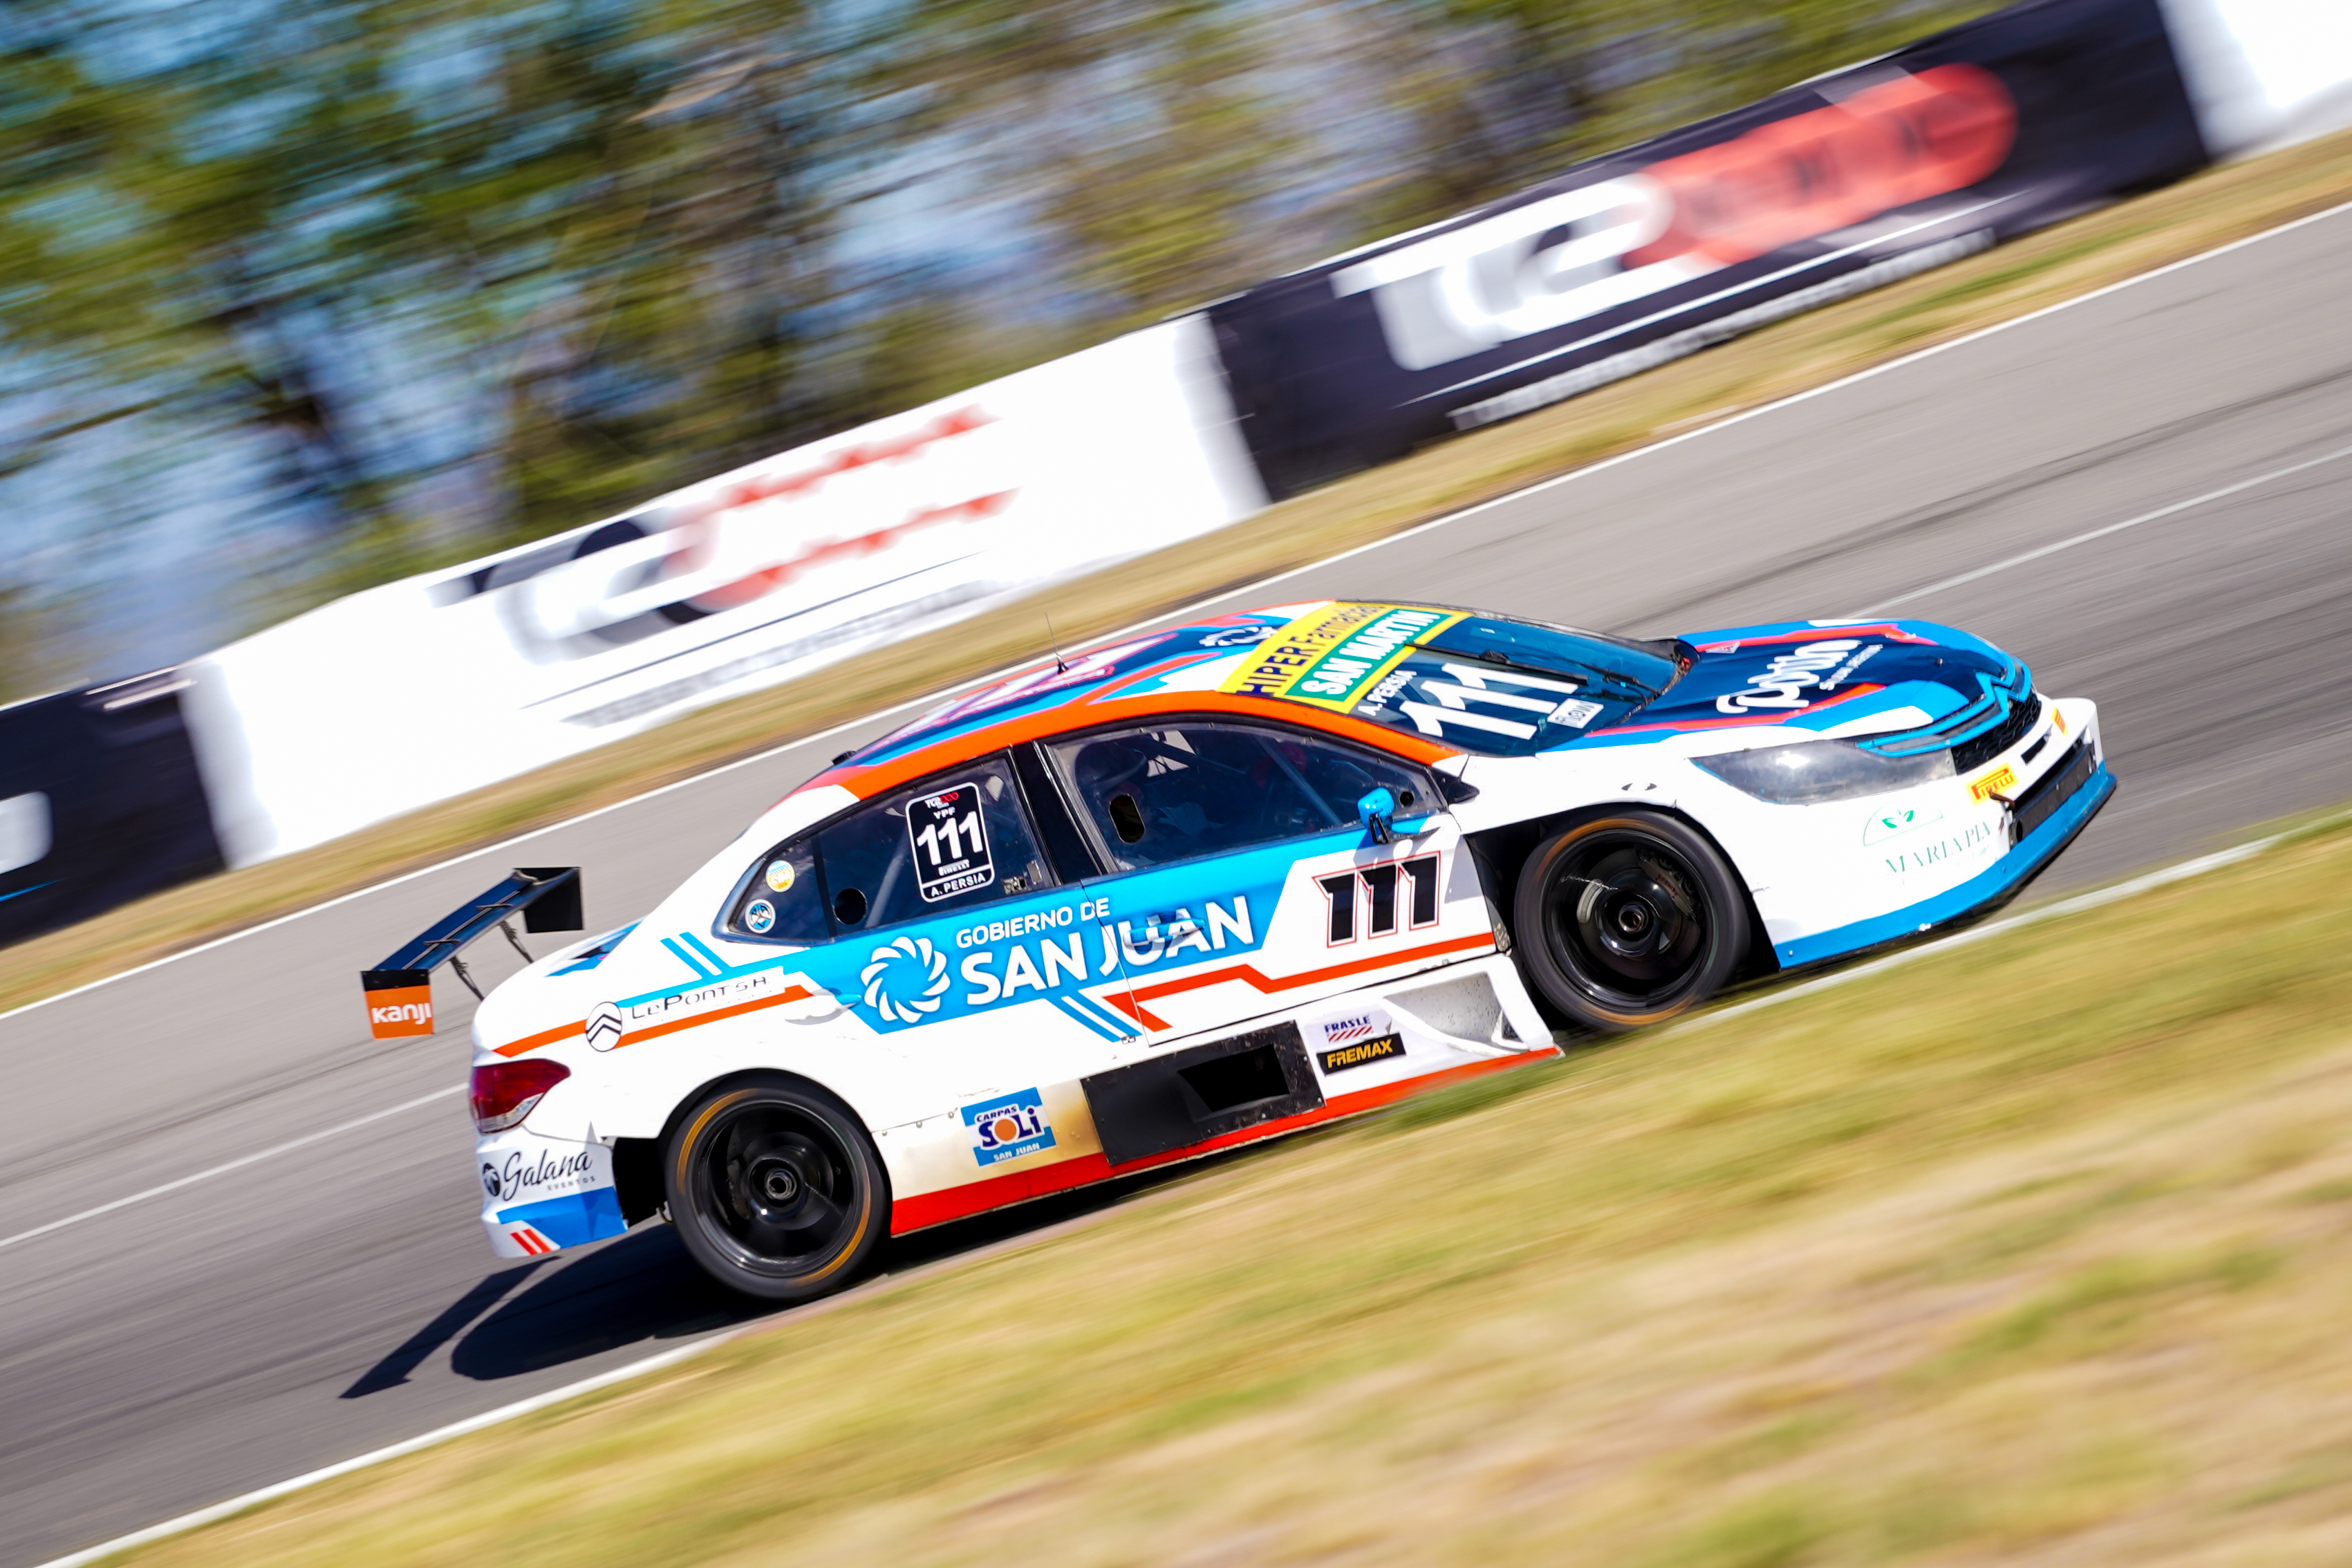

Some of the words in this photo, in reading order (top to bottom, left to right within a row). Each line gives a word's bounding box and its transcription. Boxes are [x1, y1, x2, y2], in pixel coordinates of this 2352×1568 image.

[1301, 657, 1372, 695] SAN
[1339, 610, 1441, 660] MARTIN
[1399, 662, 1578, 740] 111
[1971, 767, 2014, 800] PIRELLI
[933, 806, 955, 820] YPF
[916, 811, 983, 866] 111
[931, 886, 943, 897] A.
[943, 872, 986, 893] PERSIA
[938, 859, 970, 877] PIRELLI
[1315, 852, 1439, 946] 111
[956, 906, 1073, 948] GOBIERNO
[1081, 897, 1109, 922] DE
[960, 931, 1088, 1005] SAN
[1099, 895, 1253, 977] JUAN
[1327, 1038, 1393, 1068] FREMAX
[976, 1106, 1017, 1122] CARPAS
[993, 1150, 1012, 1161] SAN
[1016, 1143, 1040, 1157] JUAN
[503, 1148, 592, 1202] Galana
[547, 1175, 596, 1191] EVENTOS
